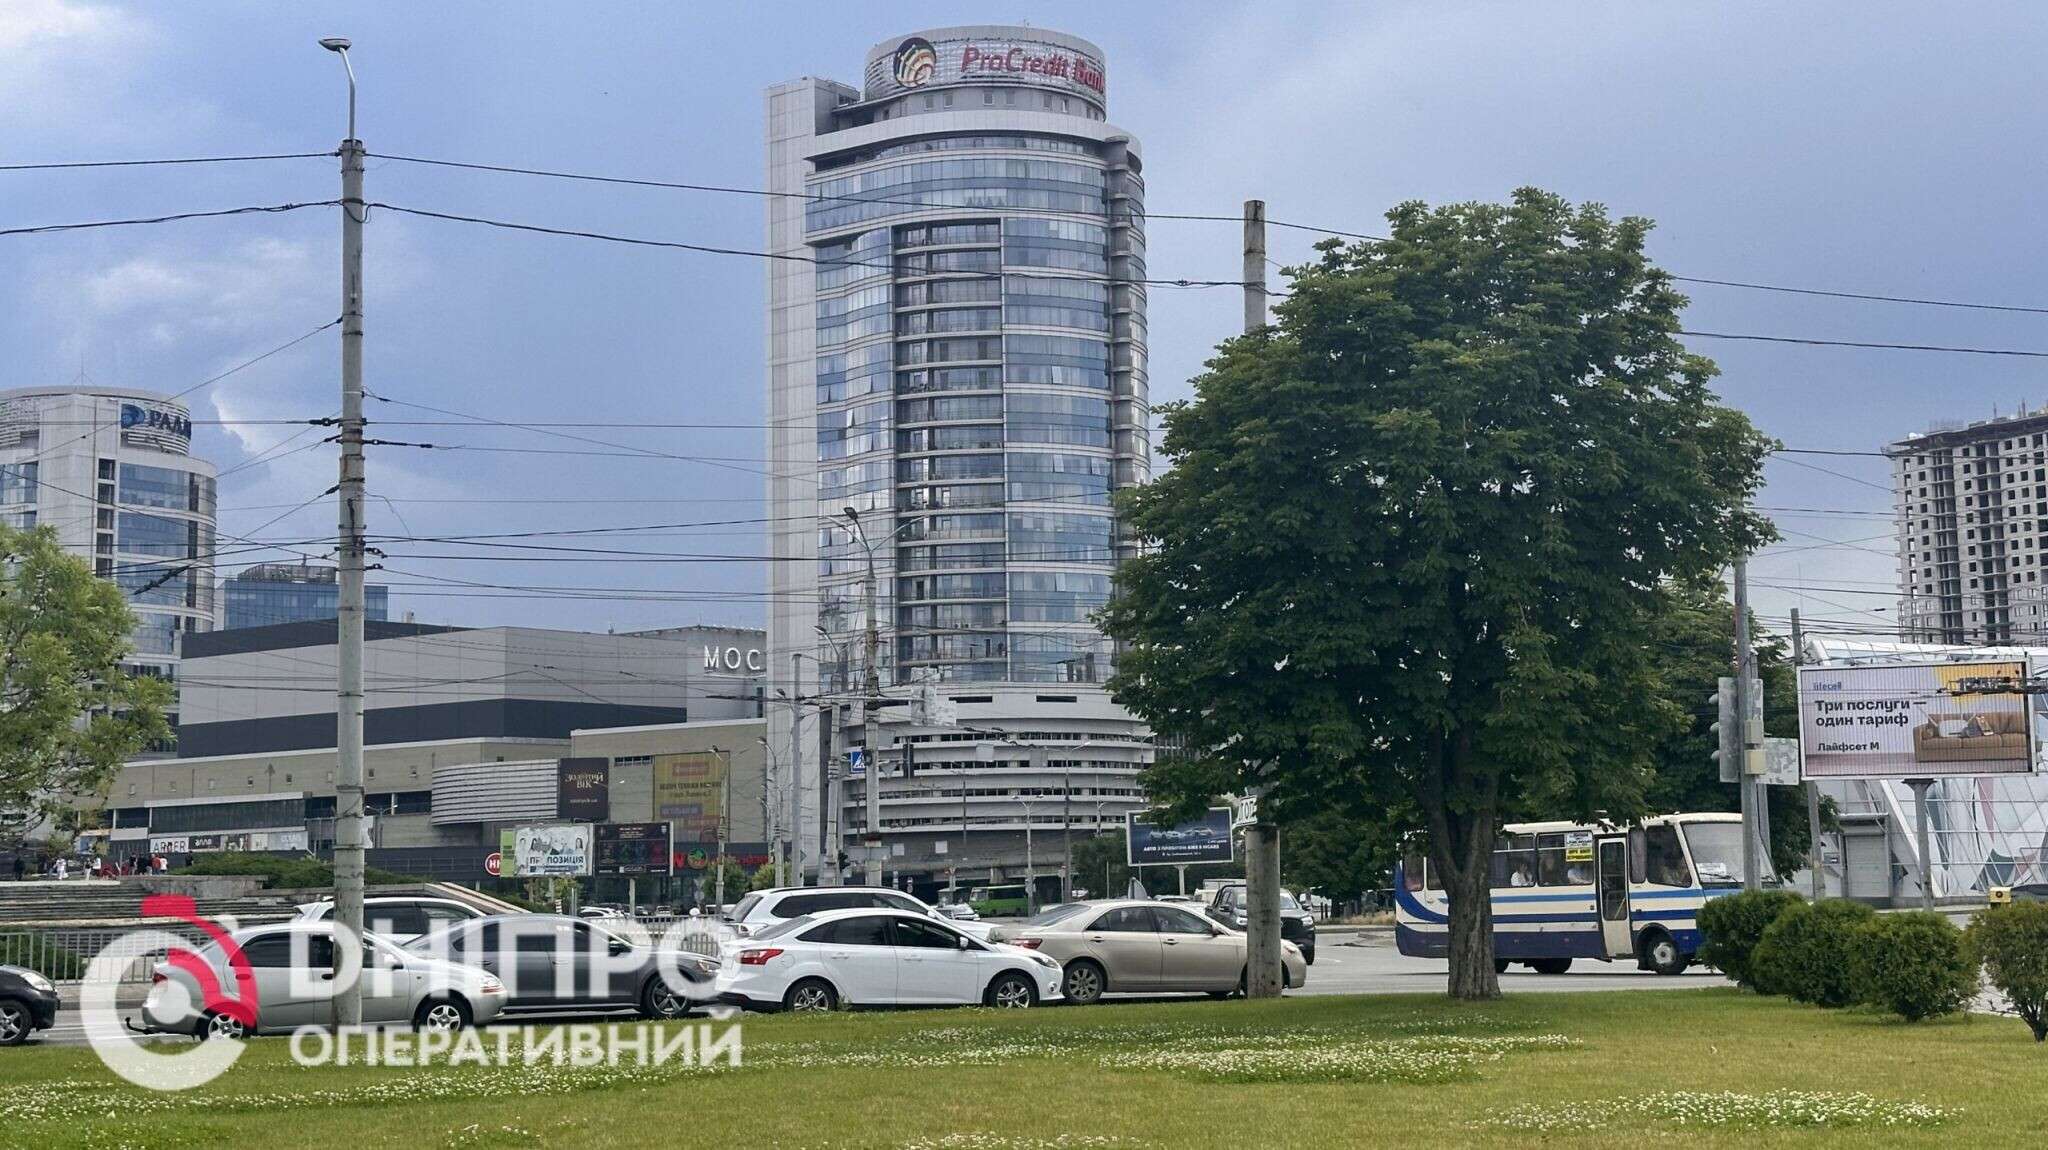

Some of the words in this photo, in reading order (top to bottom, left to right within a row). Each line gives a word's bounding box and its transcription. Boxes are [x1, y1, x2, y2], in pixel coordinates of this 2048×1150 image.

[1815, 700, 1843, 714] Три
[1847, 701, 1910, 713] послуги
[1816, 715, 1853, 727] один
[1857, 712, 1909, 727] тариф
[1817, 740, 1867, 752] Лайфсет
